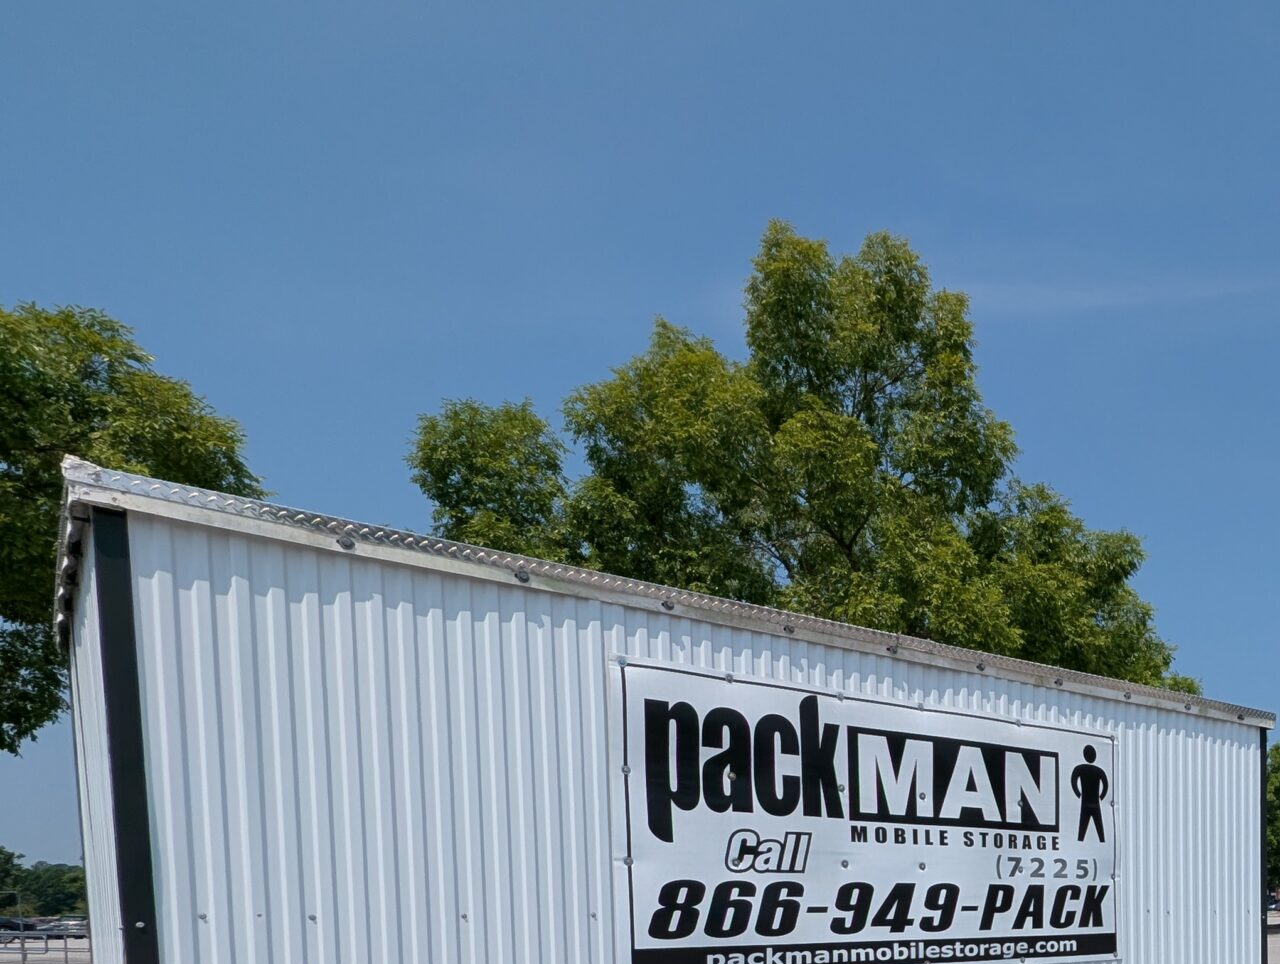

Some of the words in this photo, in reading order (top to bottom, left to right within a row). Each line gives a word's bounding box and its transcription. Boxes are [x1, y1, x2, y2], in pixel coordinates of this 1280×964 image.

[725, 829, 812, 873] Call
[851, 826, 949, 846] MOBILE
[963, 831, 1060, 851] STORAGE
[996, 855, 1099, 880] (7225)
[648, 879, 1109, 939] 866-949-PACK
